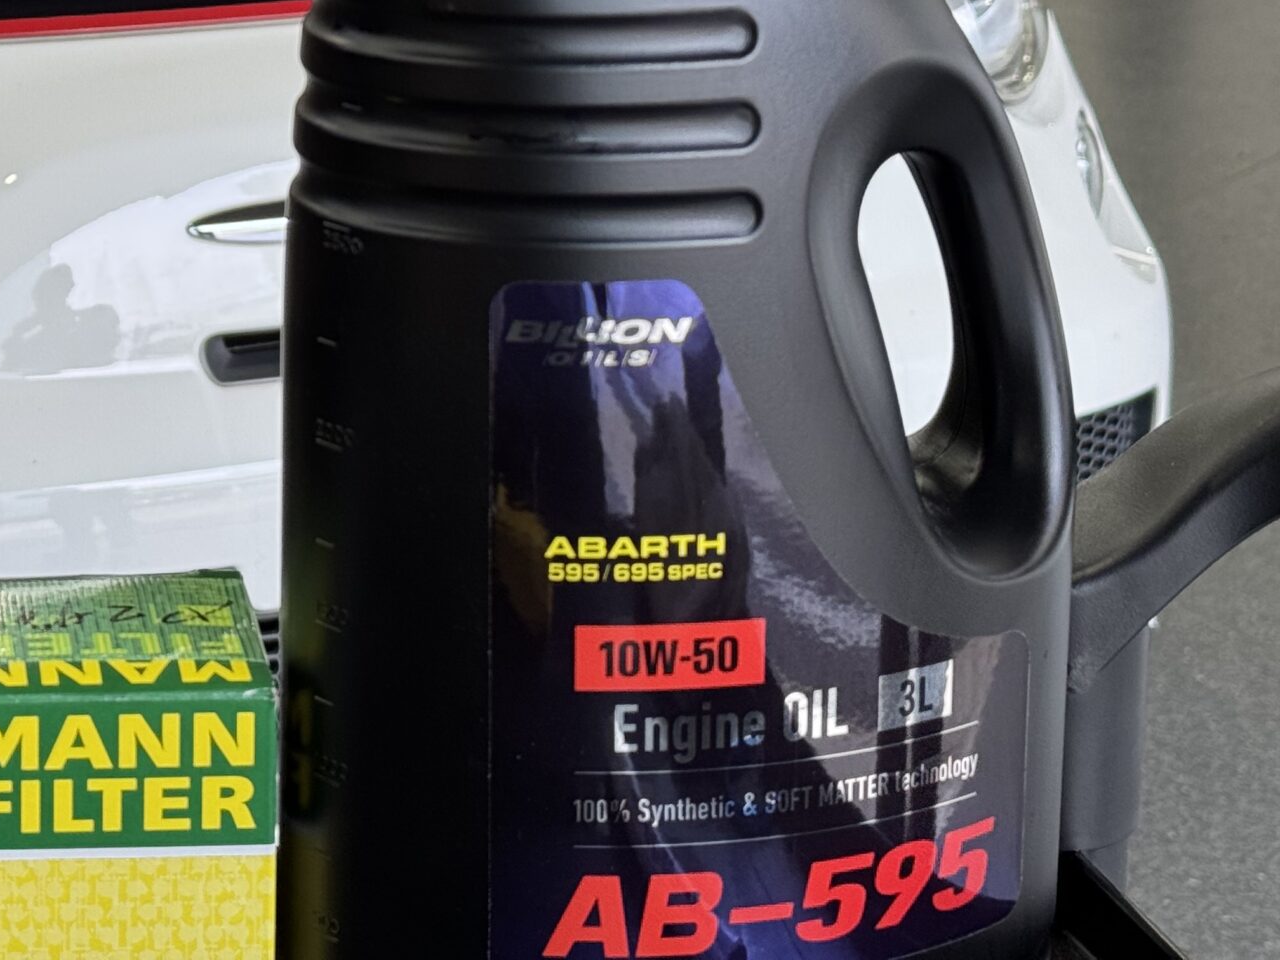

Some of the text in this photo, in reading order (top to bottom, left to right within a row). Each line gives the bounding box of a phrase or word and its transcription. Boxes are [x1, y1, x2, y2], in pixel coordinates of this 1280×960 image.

[505, 316, 693, 348] BILLION
[543, 532, 726, 560] ABARTH
[667, 562, 724, 581] SPEC
[599, 634, 740, 679] 10W-50
[899, 674, 934, 719] 3L
[613, 685, 849, 765] Engine OIL
[573, 750, 980, 828] 100% Synthetic & SOFT MATTER technology
[541, 814, 996, 960] AB-595
